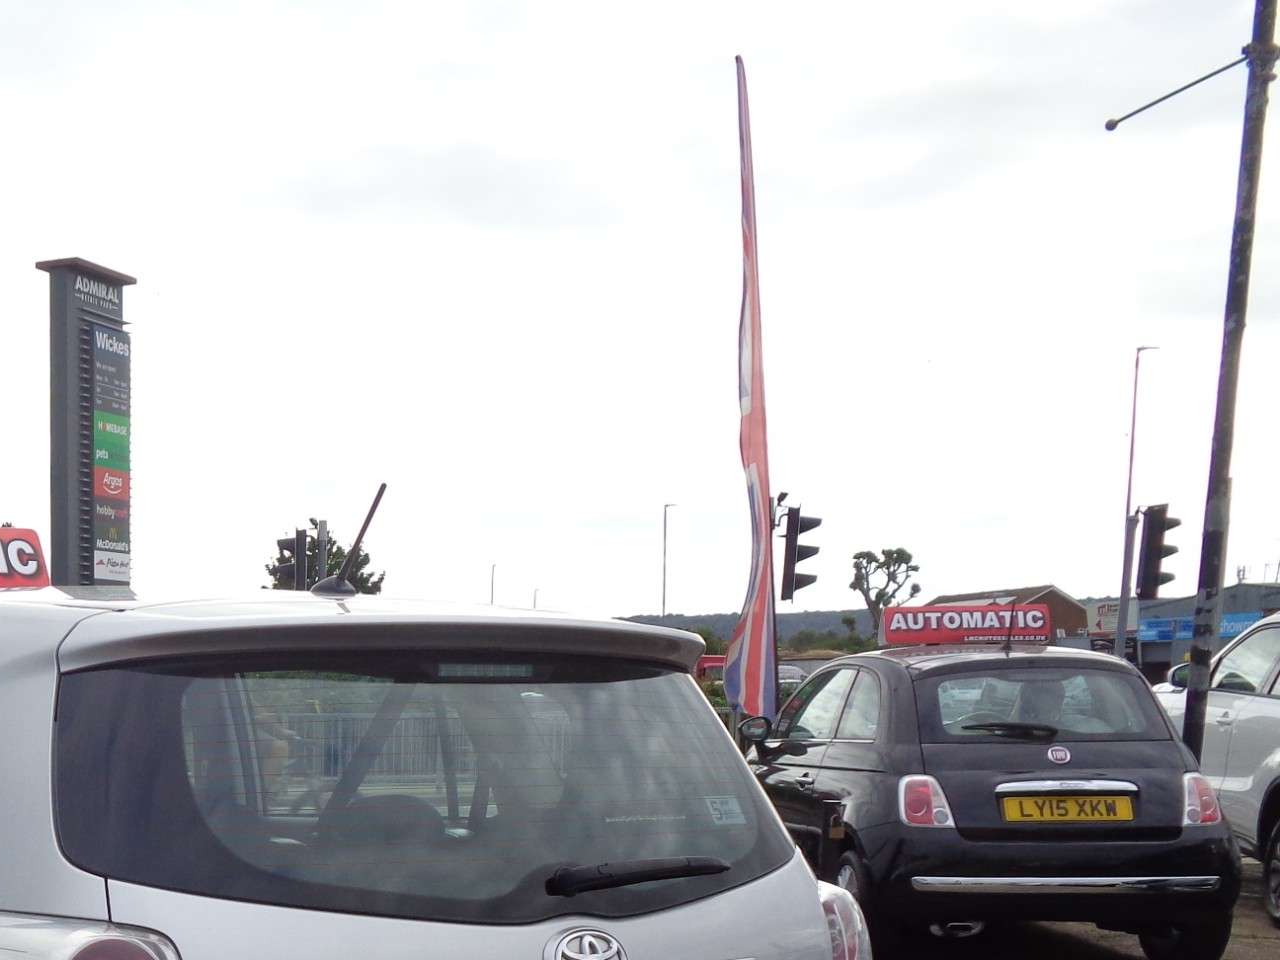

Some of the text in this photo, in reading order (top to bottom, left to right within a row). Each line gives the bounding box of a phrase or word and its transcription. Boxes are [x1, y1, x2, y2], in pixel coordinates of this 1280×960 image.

[75, 275, 119, 303] ADMIRAL
[96, 331, 129, 356] Wickes
[104, 473, 122, 488] Argos
[97, 538, 129, 552] McDonald's
[890, 610, 1044, 630] AUTOMATIC
[1019, 799, 1118, 818] LY15 XKW
